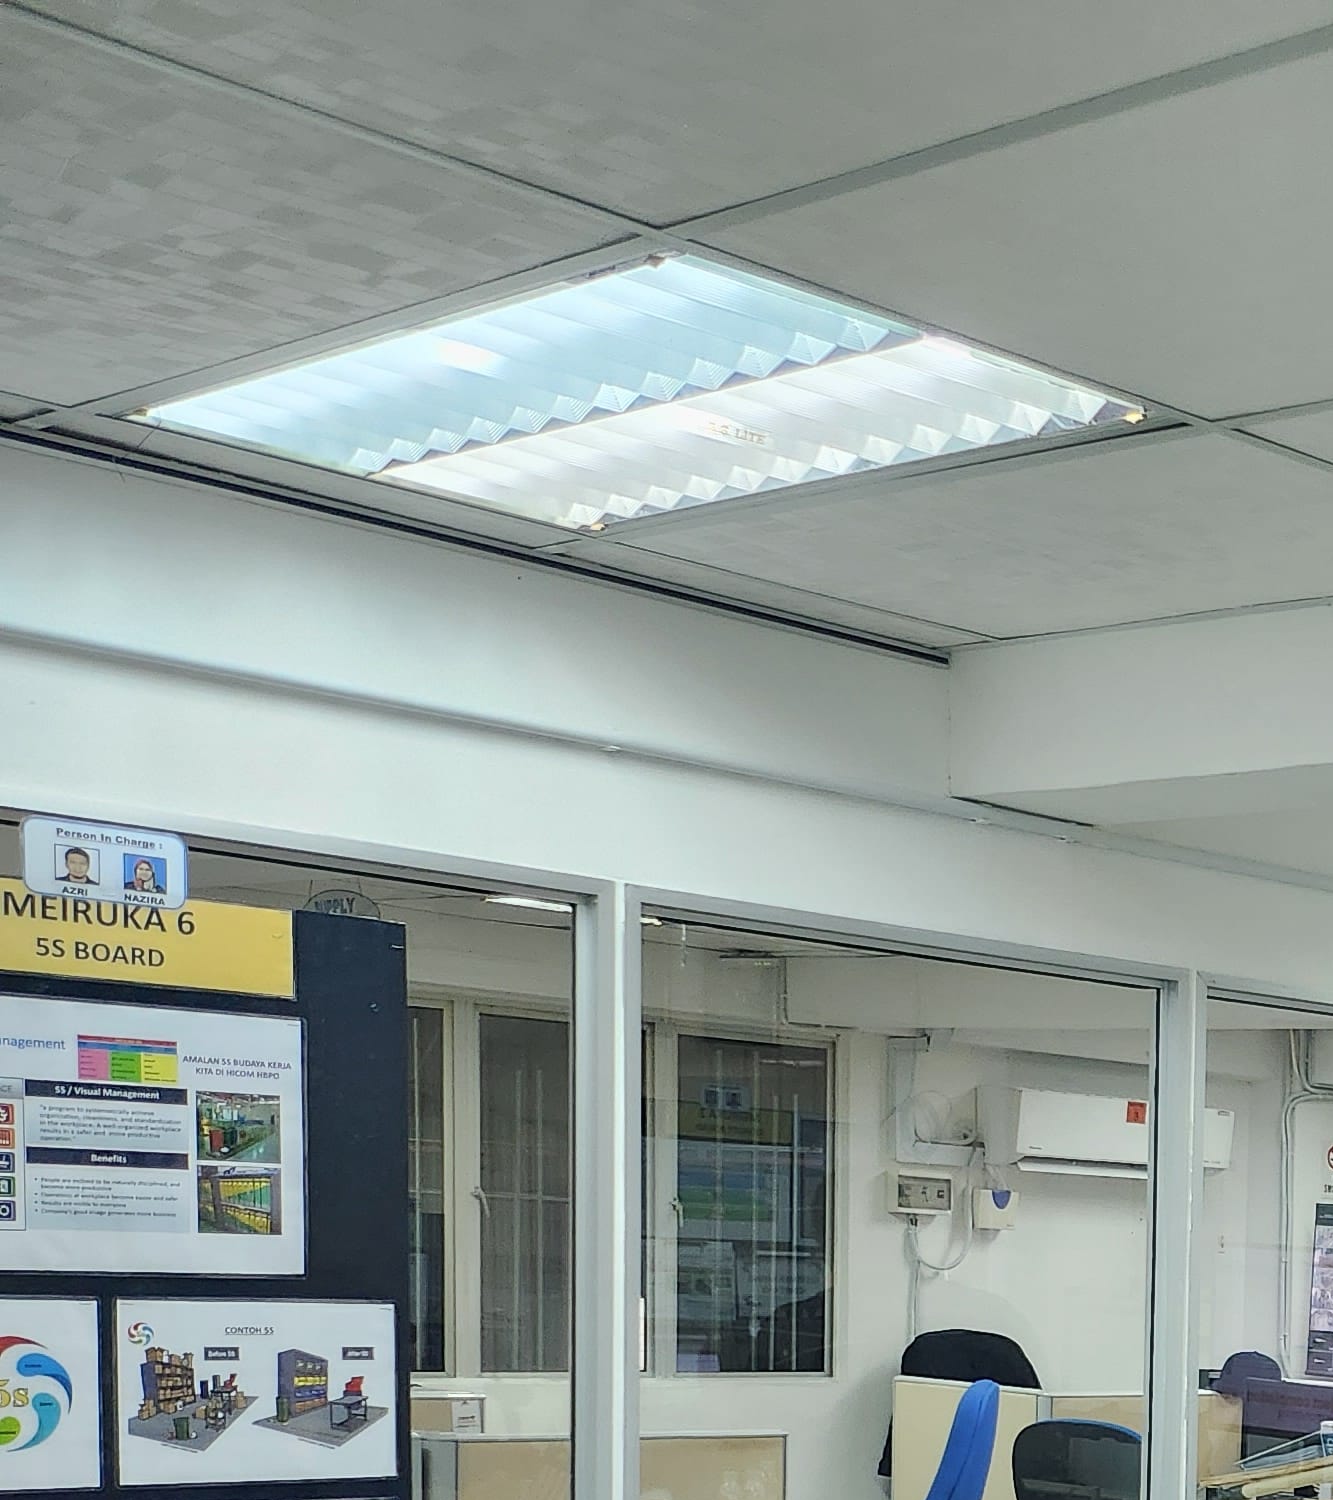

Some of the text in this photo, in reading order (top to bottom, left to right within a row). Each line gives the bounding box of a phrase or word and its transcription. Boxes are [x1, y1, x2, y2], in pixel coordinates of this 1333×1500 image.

[56, 827, 97, 841] Person
[100, 833, 112, 843] In
[115, 836, 156, 849] Charge
[62, 885, 88, 897] AZRI
[124, 893, 165, 906] NAZIRA
[3, 891, 196, 936] MEIRUKA 6
[36, 937, 165, 967] 5S BOARD
[0, 1037, 66, 1050] nagement
[182, 1055, 219, 1065] AMALAN
[233, 1059, 265, 1068] BUDAYA
[267, 1061, 292, 1070] KERJA
[195, 1067, 213, 1076] KITA
[215, 1068, 224, 1076] DI
[226, 1069, 255, 1078] HICOM
[74, 1086, 101, 1096] Visual
[102, 1087, 160, 1100] Management
[90, 1154, 127, 1164] Benefits
[224, 1326, 262, 1336] CONTOH
